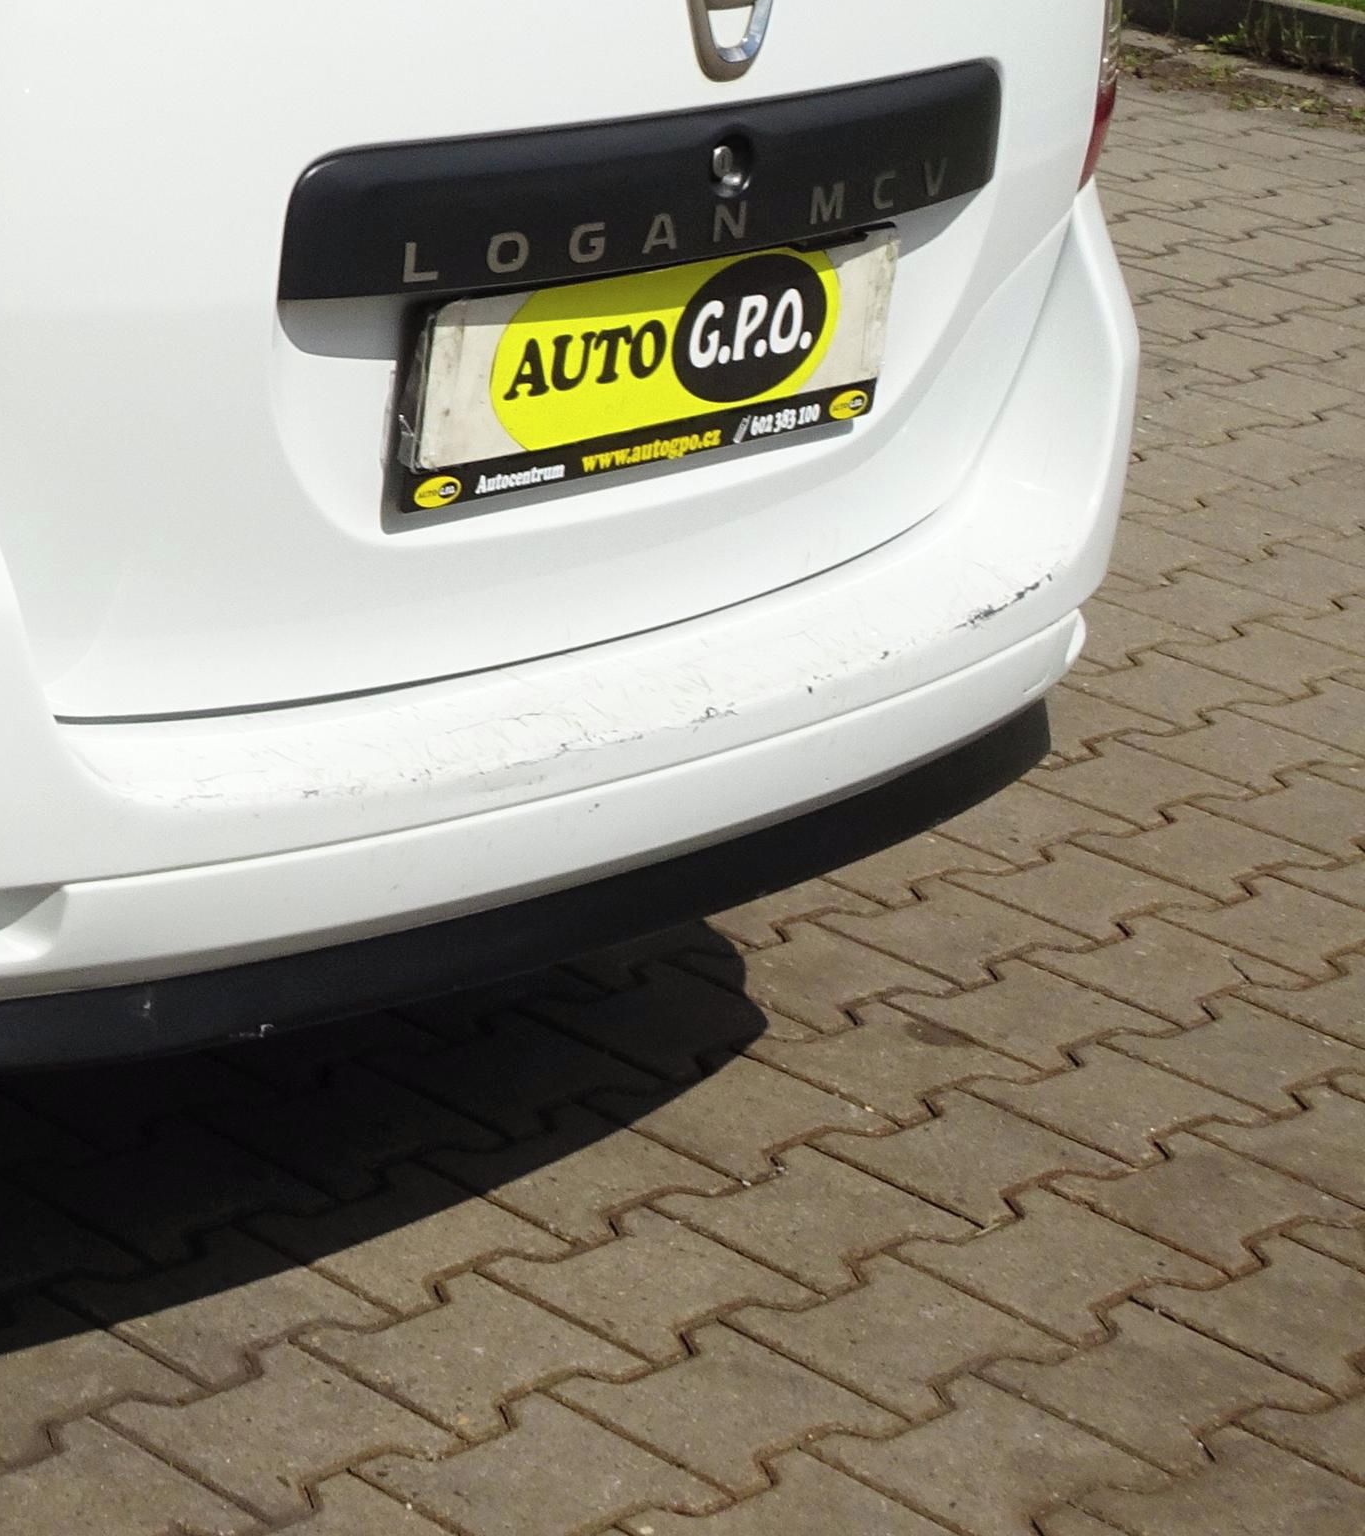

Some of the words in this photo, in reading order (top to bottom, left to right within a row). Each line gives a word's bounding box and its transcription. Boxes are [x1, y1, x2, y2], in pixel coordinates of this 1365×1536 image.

[402, 200, 748, 284] LOGAN
[810, 157, 948, 226] MCV
[503, 319, 667, 401] AUTO
[688, 288, 813, 369] G.P.O.
[475, 464, 565, 494] Autocentrum
[581, 429, 722, 473] www.autogpo.cz
[797, 403, 821, 425] 100
